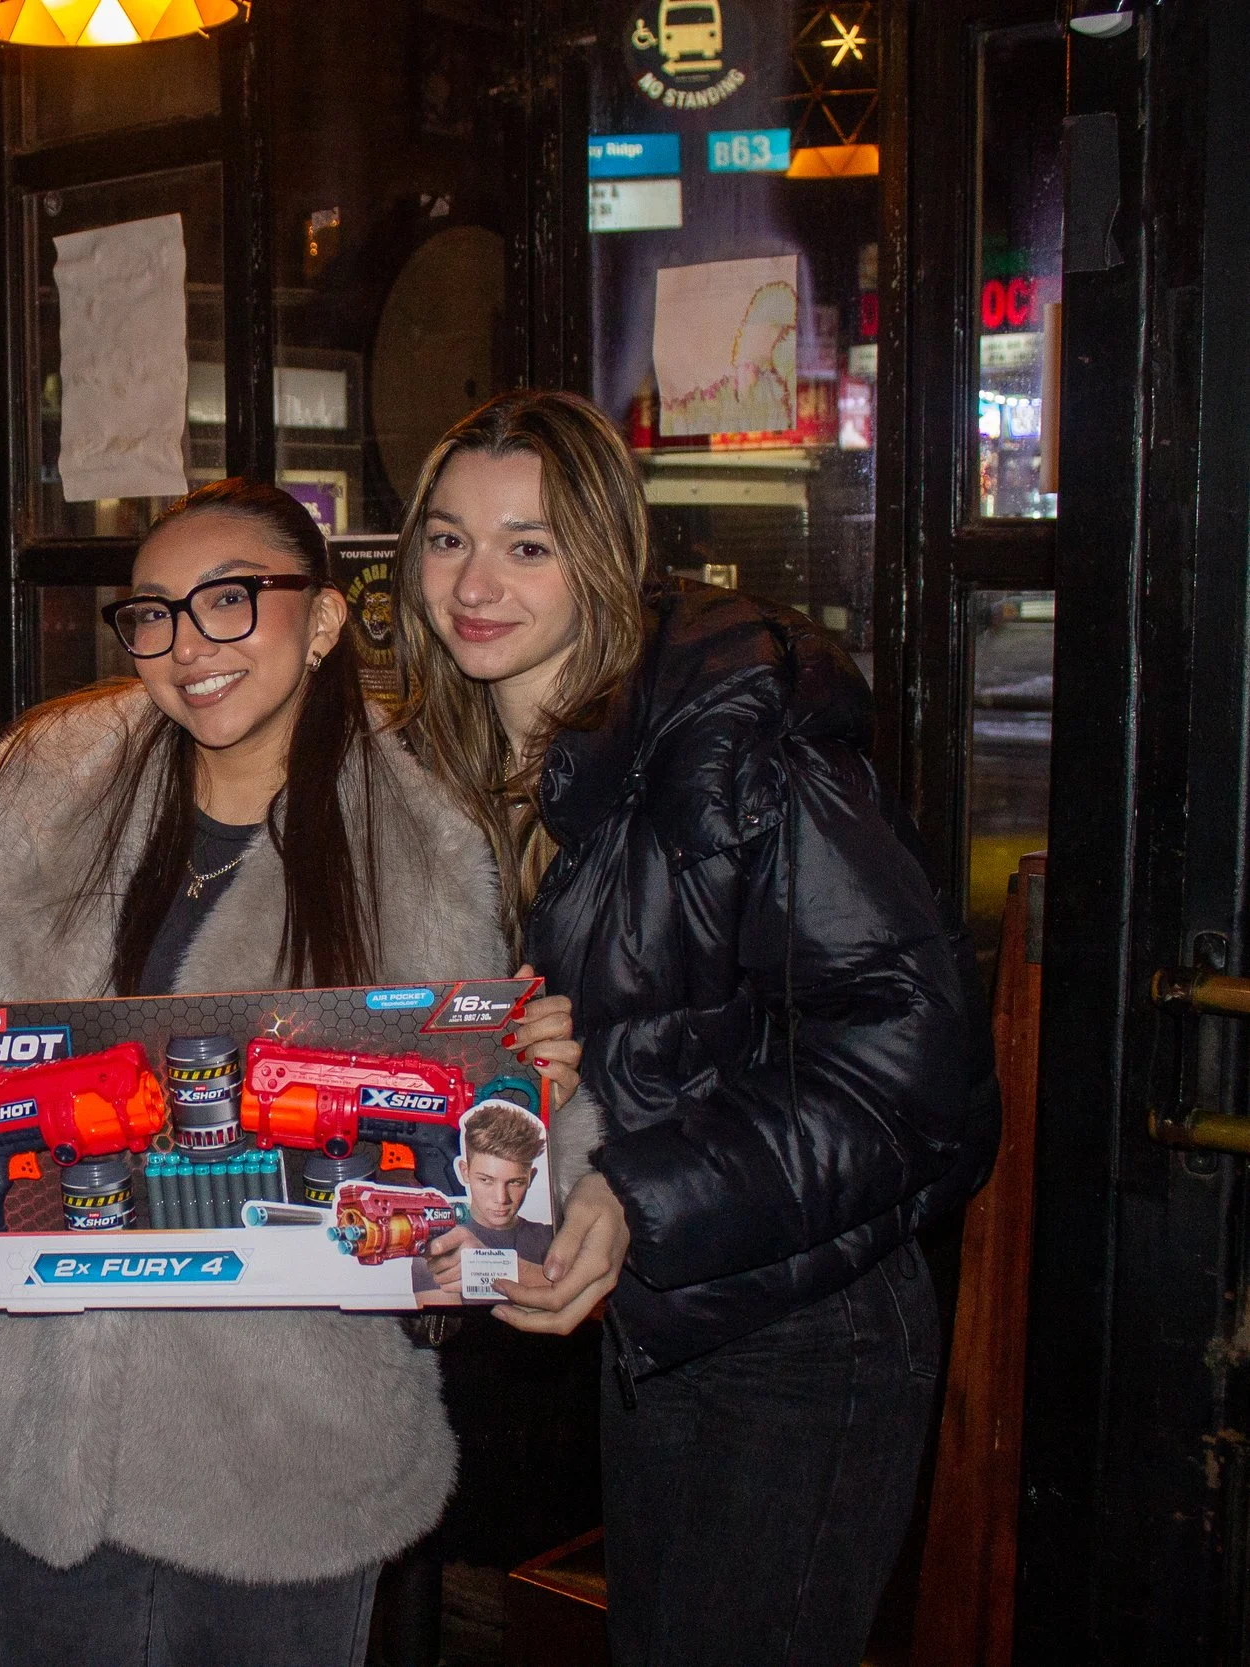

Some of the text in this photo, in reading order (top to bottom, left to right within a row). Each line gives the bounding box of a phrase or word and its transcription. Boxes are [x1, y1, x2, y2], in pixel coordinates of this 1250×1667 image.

[638, 68, 746, 110] NO STANDING
[606, 142, 643, 158] Ridge
[713, 135, 772, 167] B63
[390, 993, 426, 1001] POCKET
[54, 1259, 92, 1277] 2x
[101, 1257, 192, 1277] FURY
